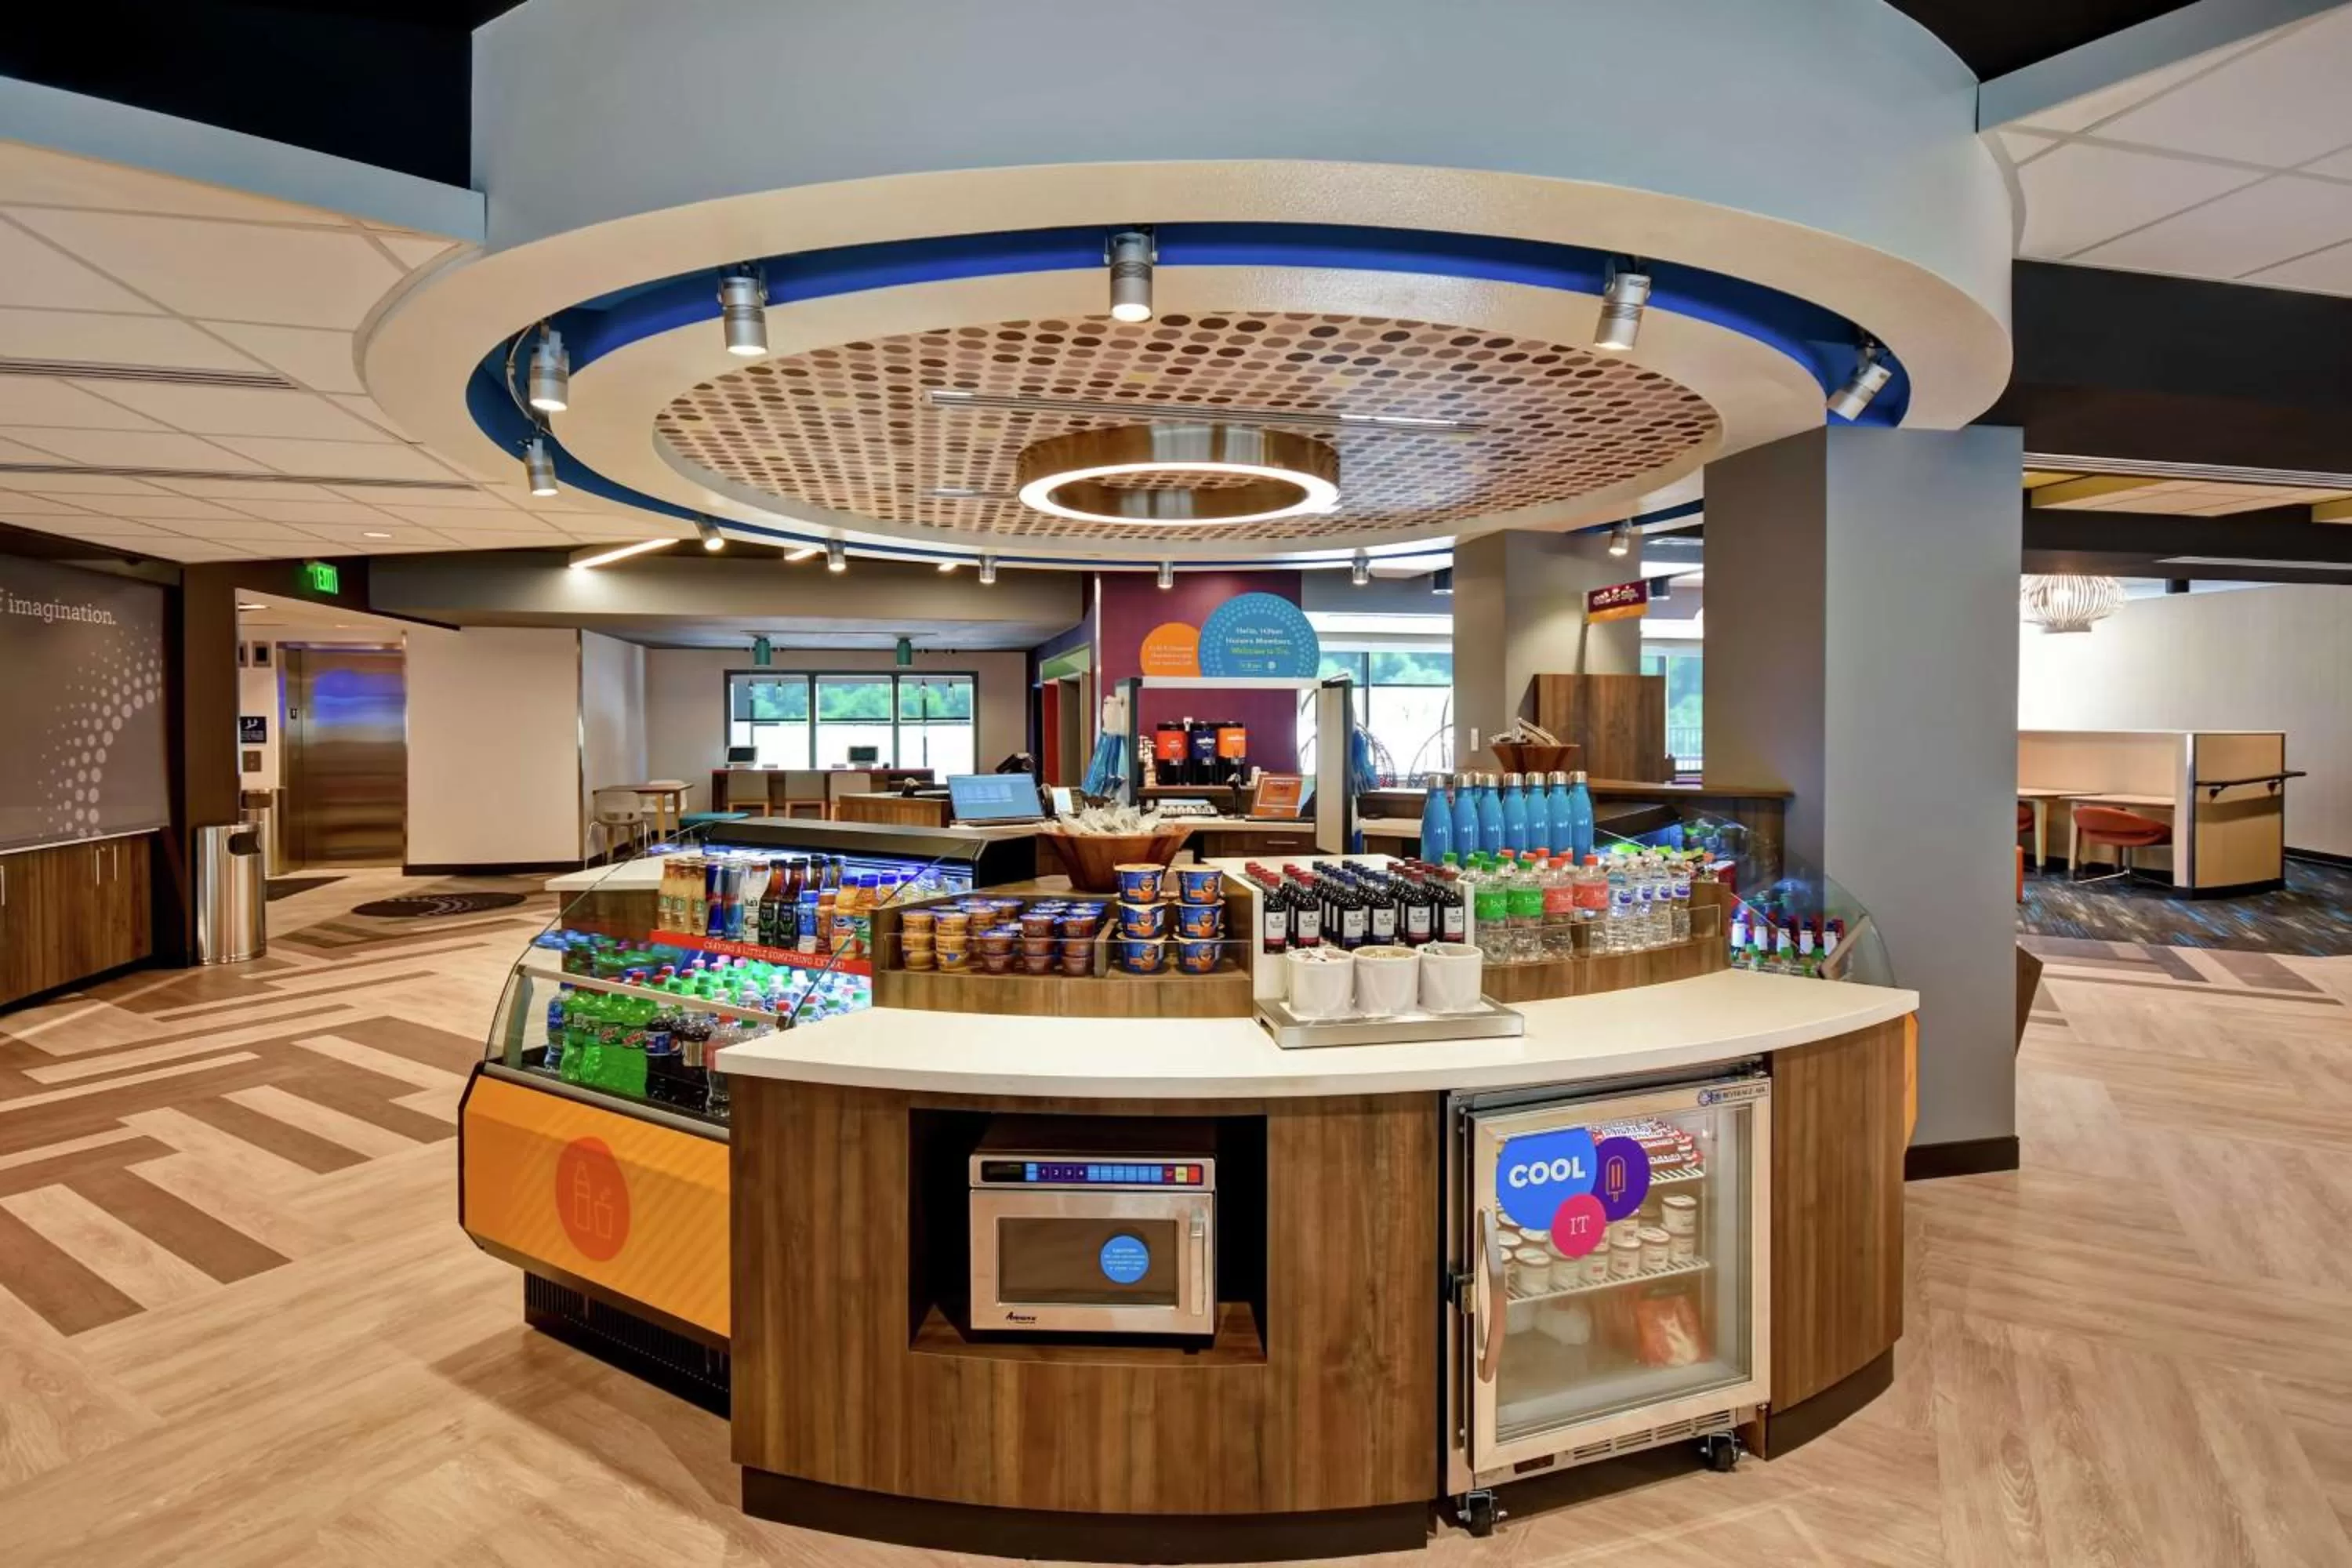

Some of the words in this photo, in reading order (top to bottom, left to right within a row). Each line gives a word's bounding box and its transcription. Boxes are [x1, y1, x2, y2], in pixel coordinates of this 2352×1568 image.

[318, 565, 334, 593] EXIT
[8, 592, 117, 625] imagination.
[768, 950, 814, 965] SOMETHING
[1508, 1156, 1586, 1189] COOL
[1570, 1214, 1590, 1235] IT
